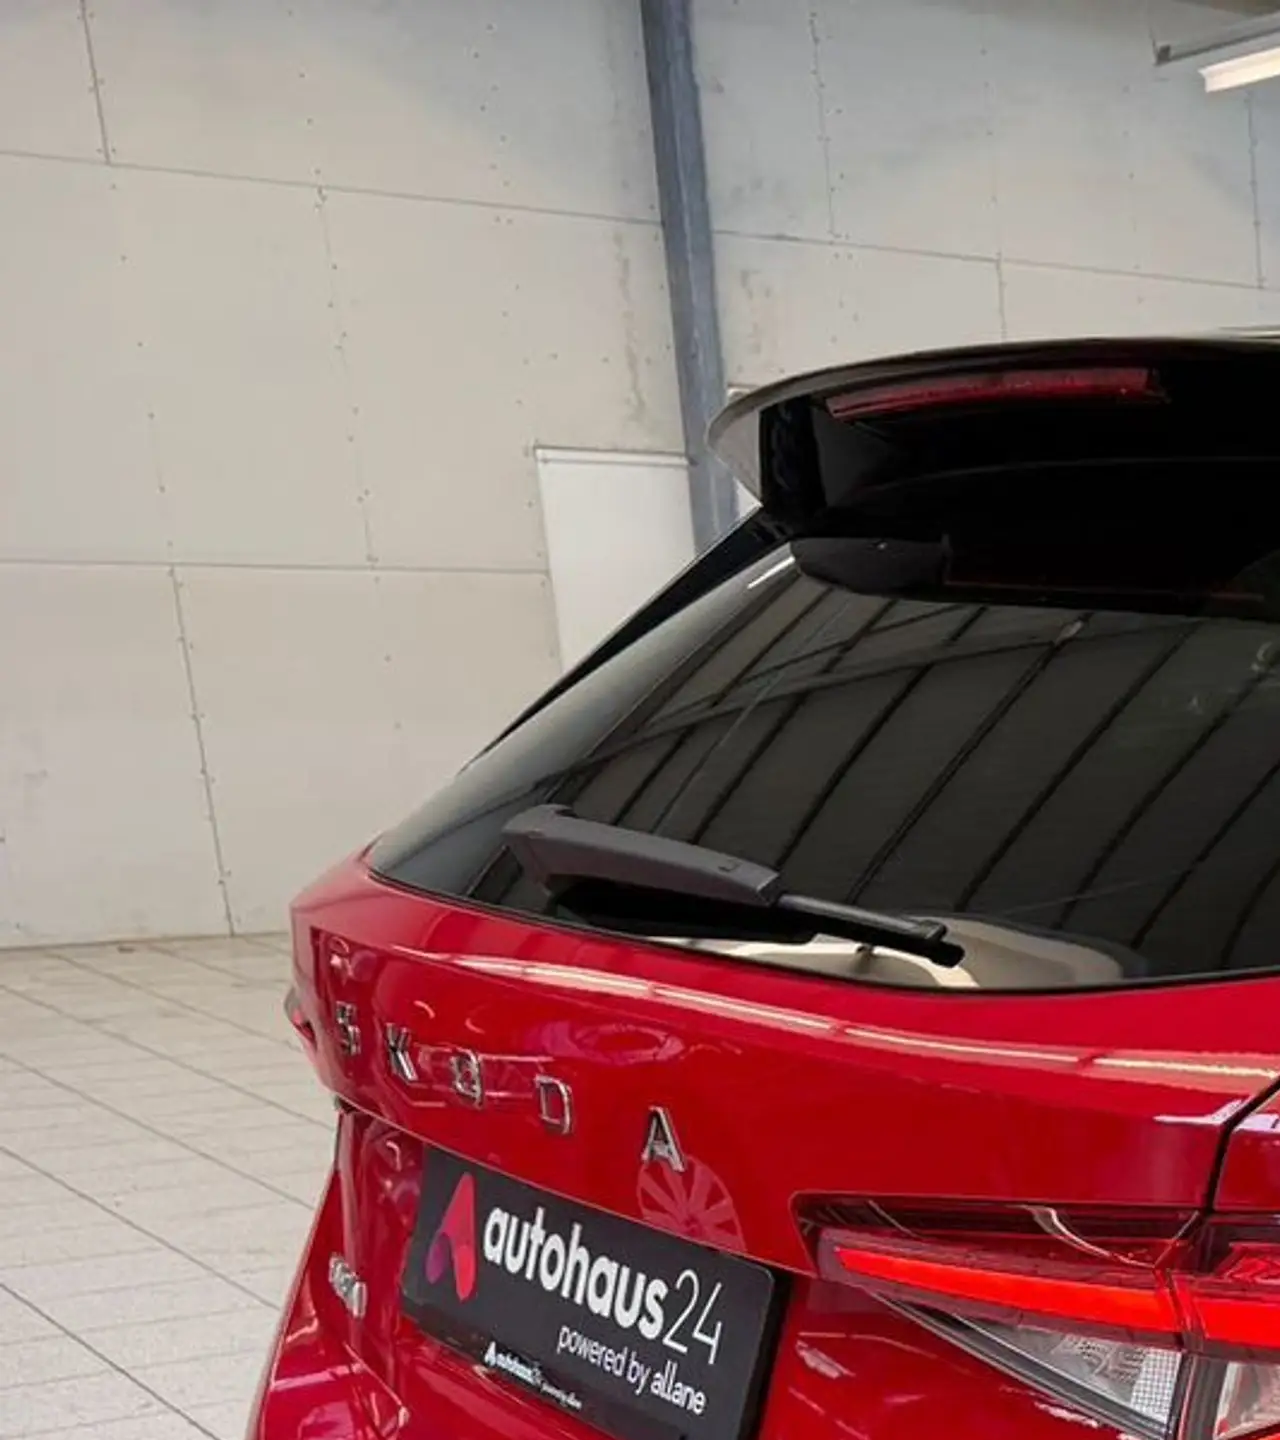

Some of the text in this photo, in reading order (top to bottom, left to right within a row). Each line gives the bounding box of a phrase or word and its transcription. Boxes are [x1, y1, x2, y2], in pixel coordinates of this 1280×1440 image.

[483, 1206, 723, 1366] autohaus24
[556, 1326, 628, 1377] powered
[627, 1351, 651, 1396] by
[650, 1360, 707, 1416] allane
